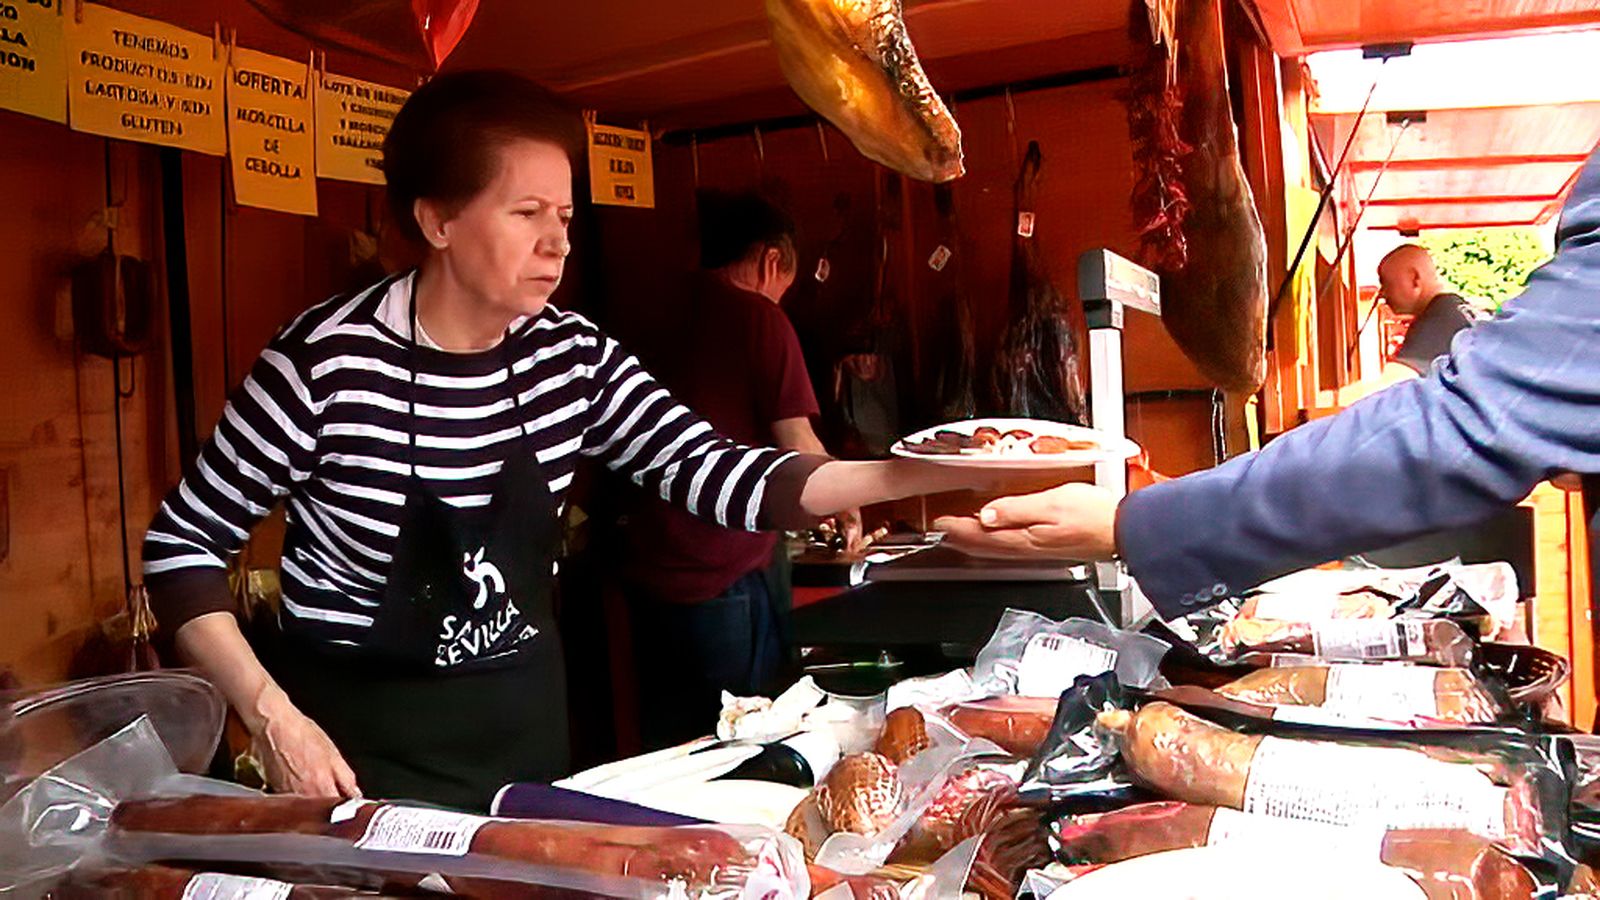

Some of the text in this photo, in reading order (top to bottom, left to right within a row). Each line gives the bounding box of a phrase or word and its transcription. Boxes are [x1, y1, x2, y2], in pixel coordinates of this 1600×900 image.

[113, 30, 189, 59] TENEMOS
[81, 50, 178, 84] PRODUCTOS
[85, 79, 159, 106] LACTOSA
[238, 70, 304, 99] OFERTA
[121, 113, 183, 135] GLUTEN
[237, 107, 306, 133] MORCILLA
[264, 138, 280, 154] DE
[245, 157, 301, 178] CEBOLLA
